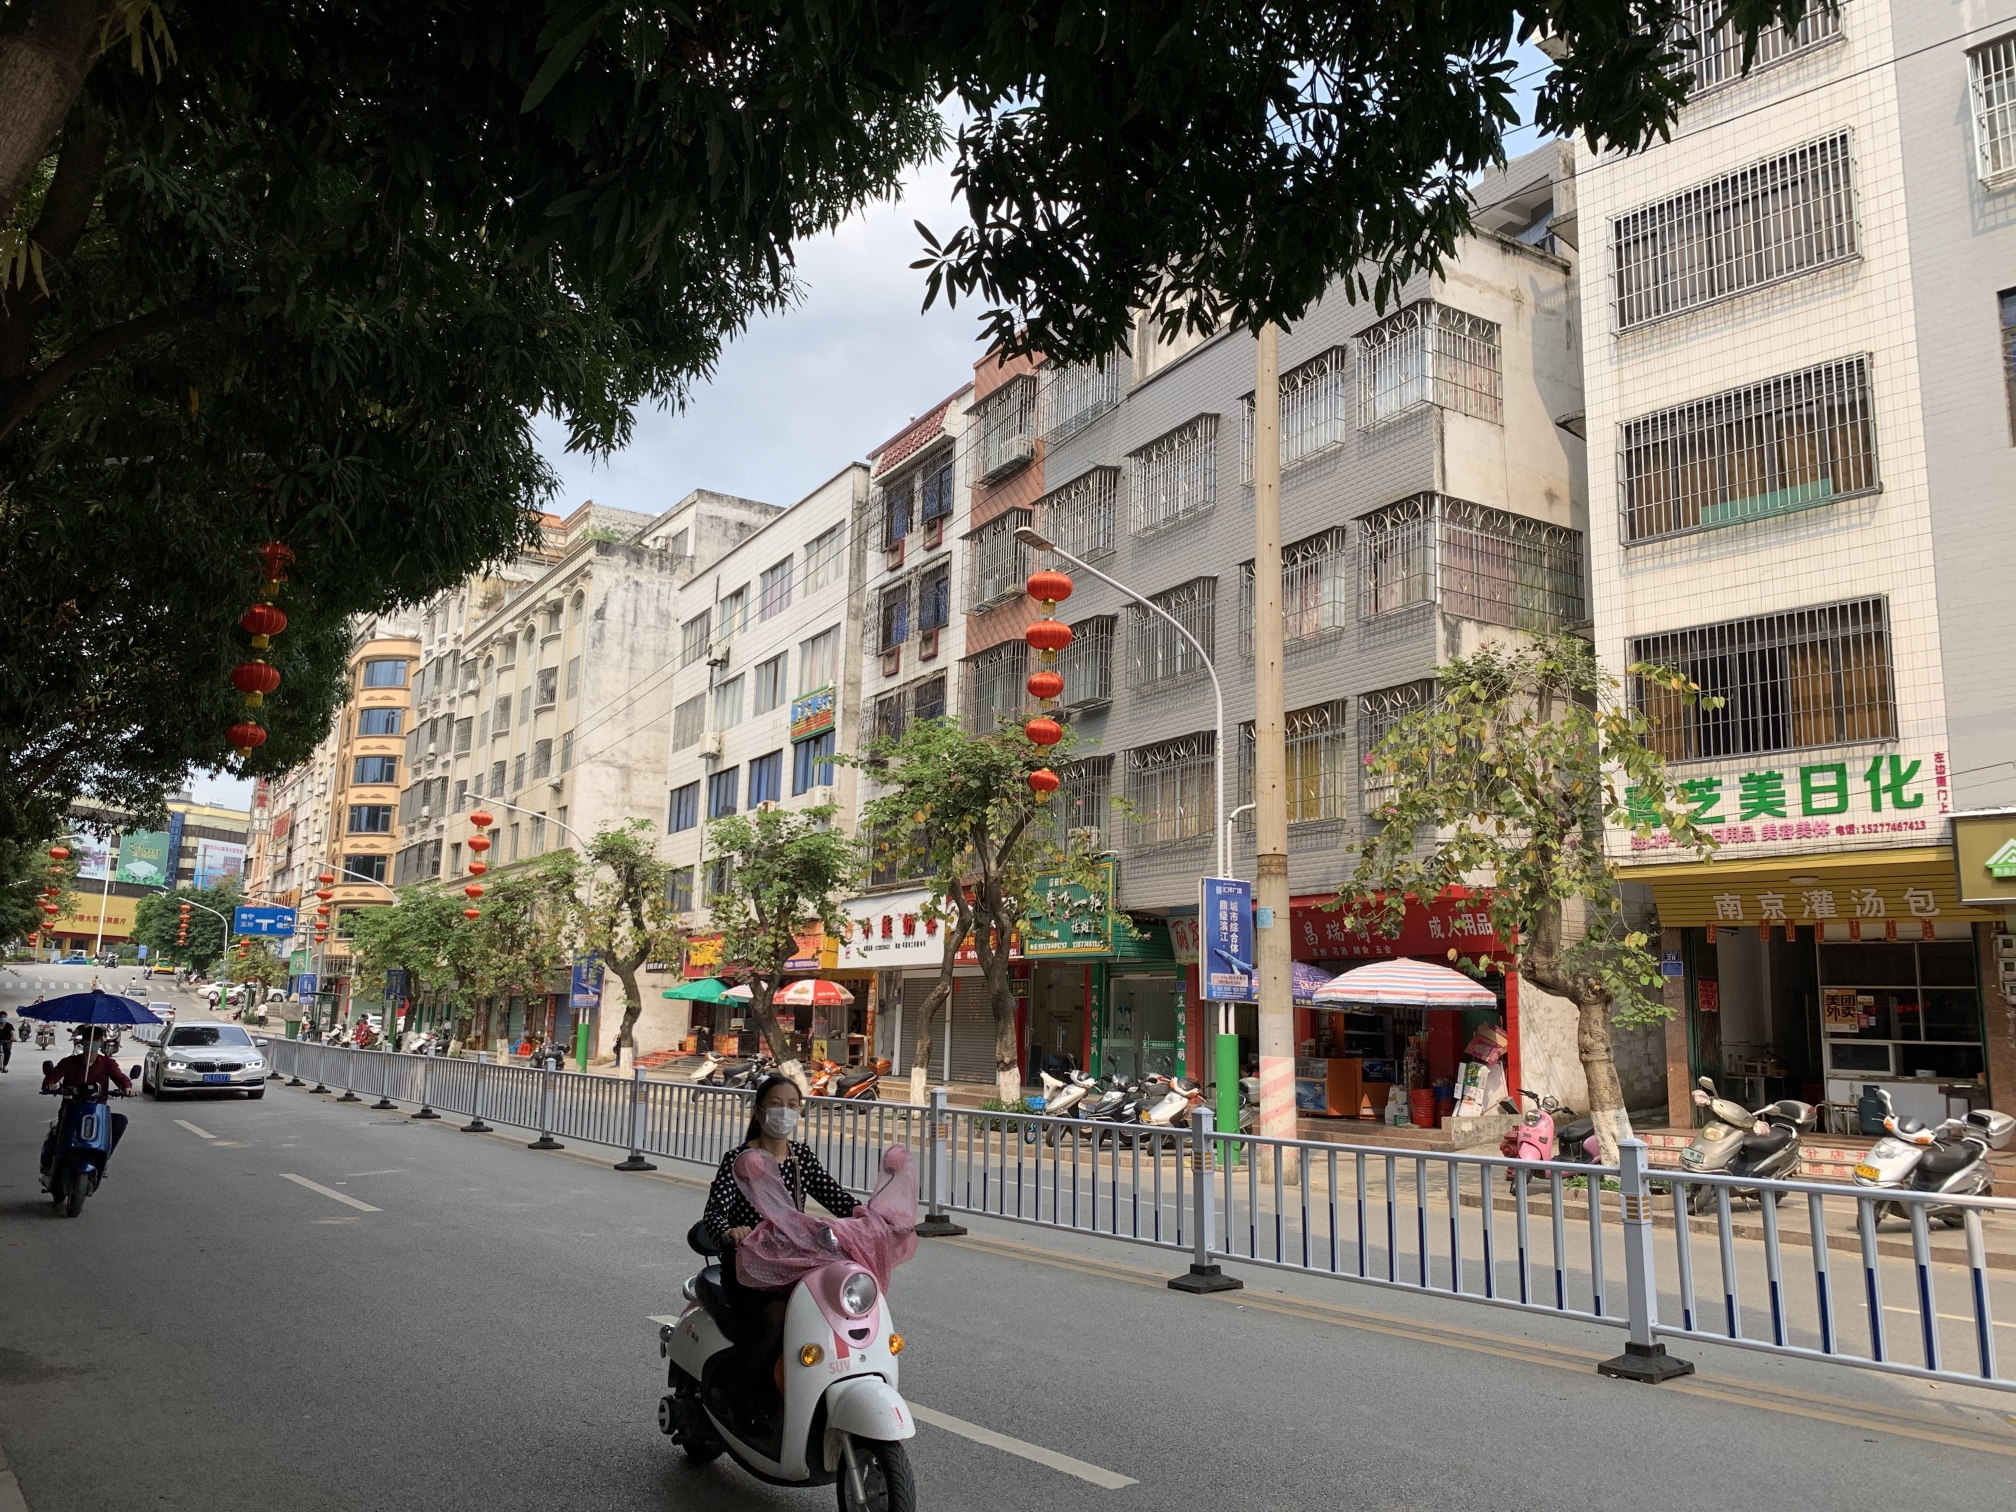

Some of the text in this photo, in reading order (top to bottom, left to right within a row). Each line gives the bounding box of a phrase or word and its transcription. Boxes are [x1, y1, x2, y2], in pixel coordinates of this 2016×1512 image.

[1934, 751, 1950, 814] 左边侧门上
[1711, 825, 1756, 845] 日用品
[1761, 819, 1830, 841] 美容美体
[1712, 886, 1941, 920] 南京灌汤包
[1229, 901, 1239, 954] 城市综合体
[1303, 917, 1400, 946] 昌瑞商
[1825, 994, 1856, 1007] 美团
[1826, 1006, 1857, 1022] 外卖
[828, 1360, 851, 1374] SUV
